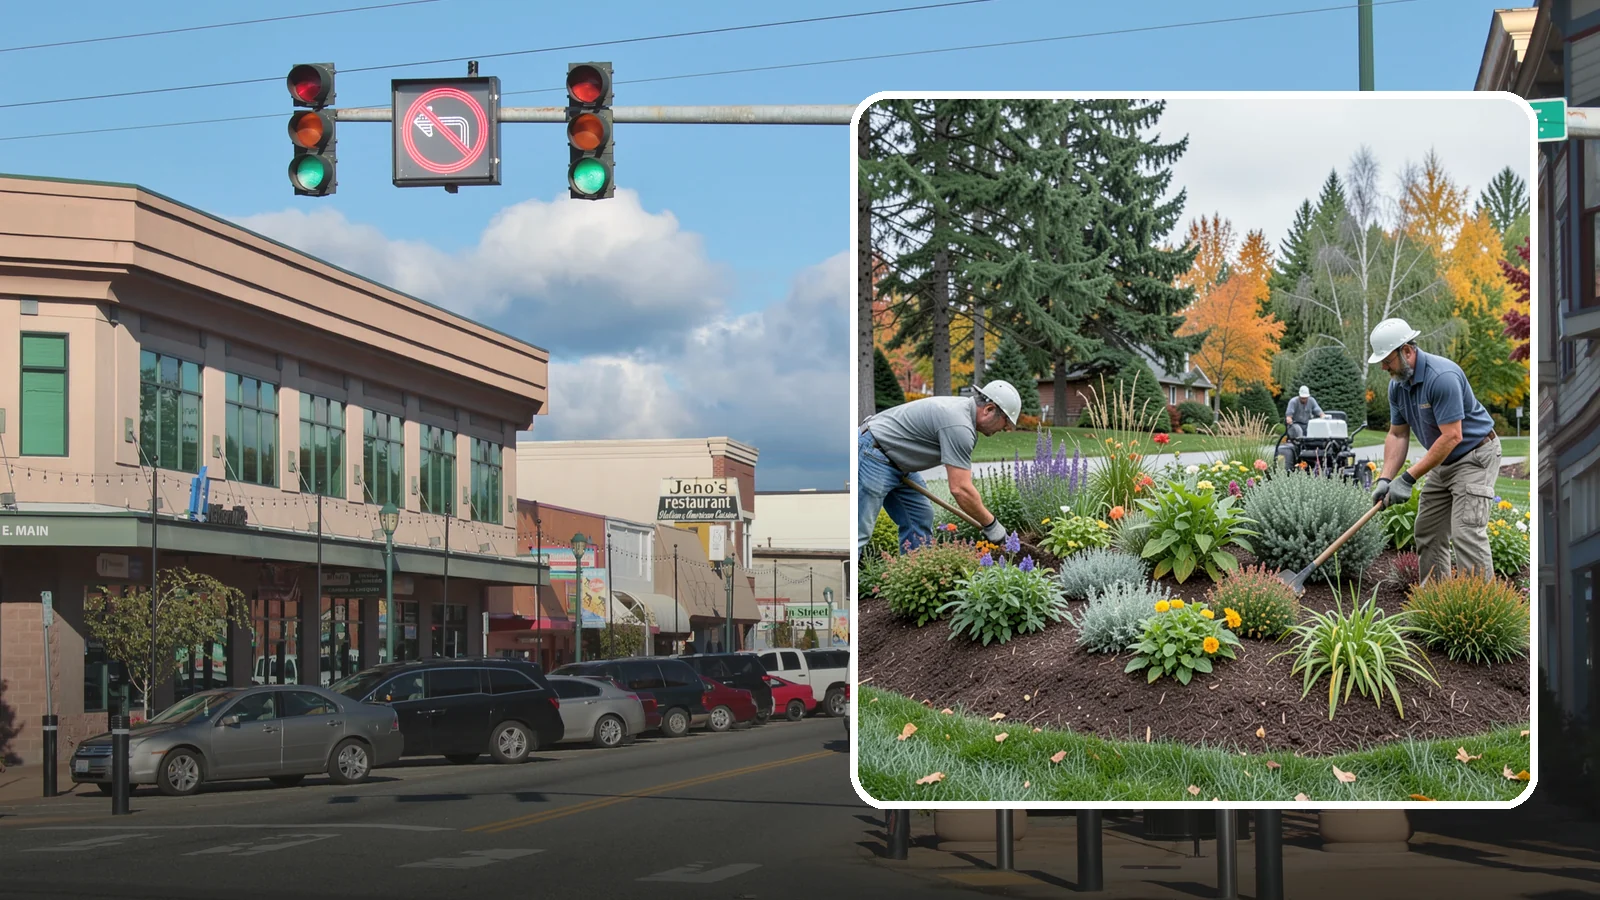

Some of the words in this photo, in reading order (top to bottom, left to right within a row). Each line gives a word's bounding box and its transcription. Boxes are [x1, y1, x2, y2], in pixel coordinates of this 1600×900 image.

[670, 480, 727, 494] Jeno's
[665, 496, 731, 509] restaurant
[659, 510, 682, 519] Italian
[686, 510, 714, 519] American
[715, 510, 737, 519] Cuisine
[2, 525, 13, 536] E.
[15, 525, 49, 536] MAIN
[797, 607, 828, 616] Street
